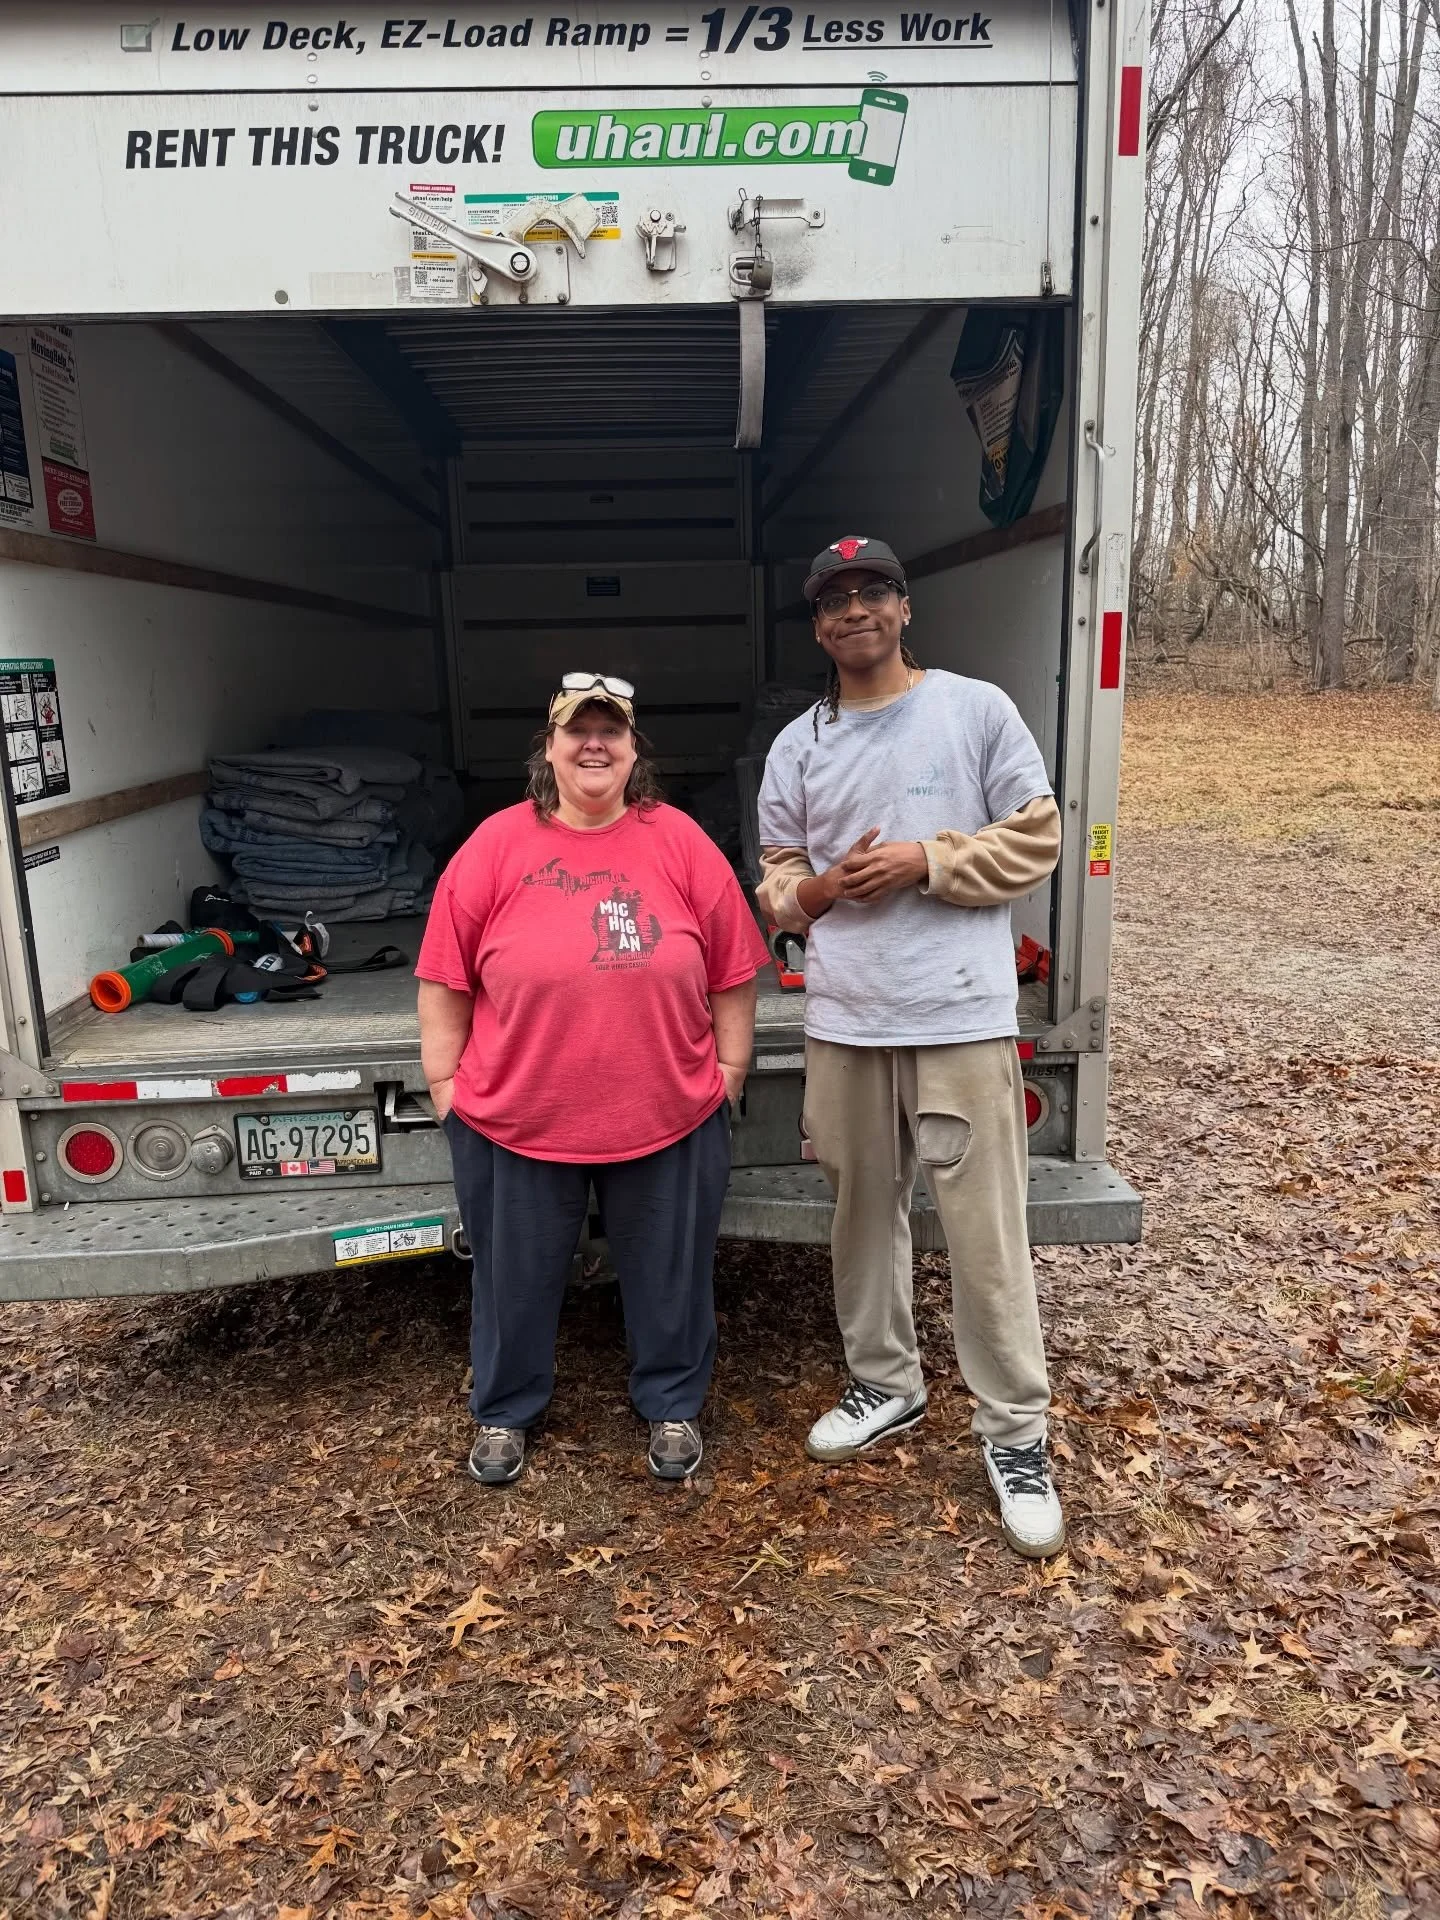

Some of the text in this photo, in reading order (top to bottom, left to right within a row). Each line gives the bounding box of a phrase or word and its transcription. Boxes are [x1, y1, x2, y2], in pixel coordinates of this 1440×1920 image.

[171, 22, 250, 52] Low
[262, 20, 367, 55] Deck,
[380, 17, 534, 49] EZ-Load
[546, 18, 651, 52] Ramp
[701, 5, 794, 54] 1/3
[803, 14, 885, 43] Less
[901, 12, 993, 42] Work
[125, 124, 506, 170] RENT THIS TRUCK!
[553, 112, 868, 162] uhaul.com
[600, 900, 629, 917] MIC
[608, 915, 637, 935] HIG
[618, 932, 641, 952] AN
[272, 1113, 343, 1124] ARIZONA
